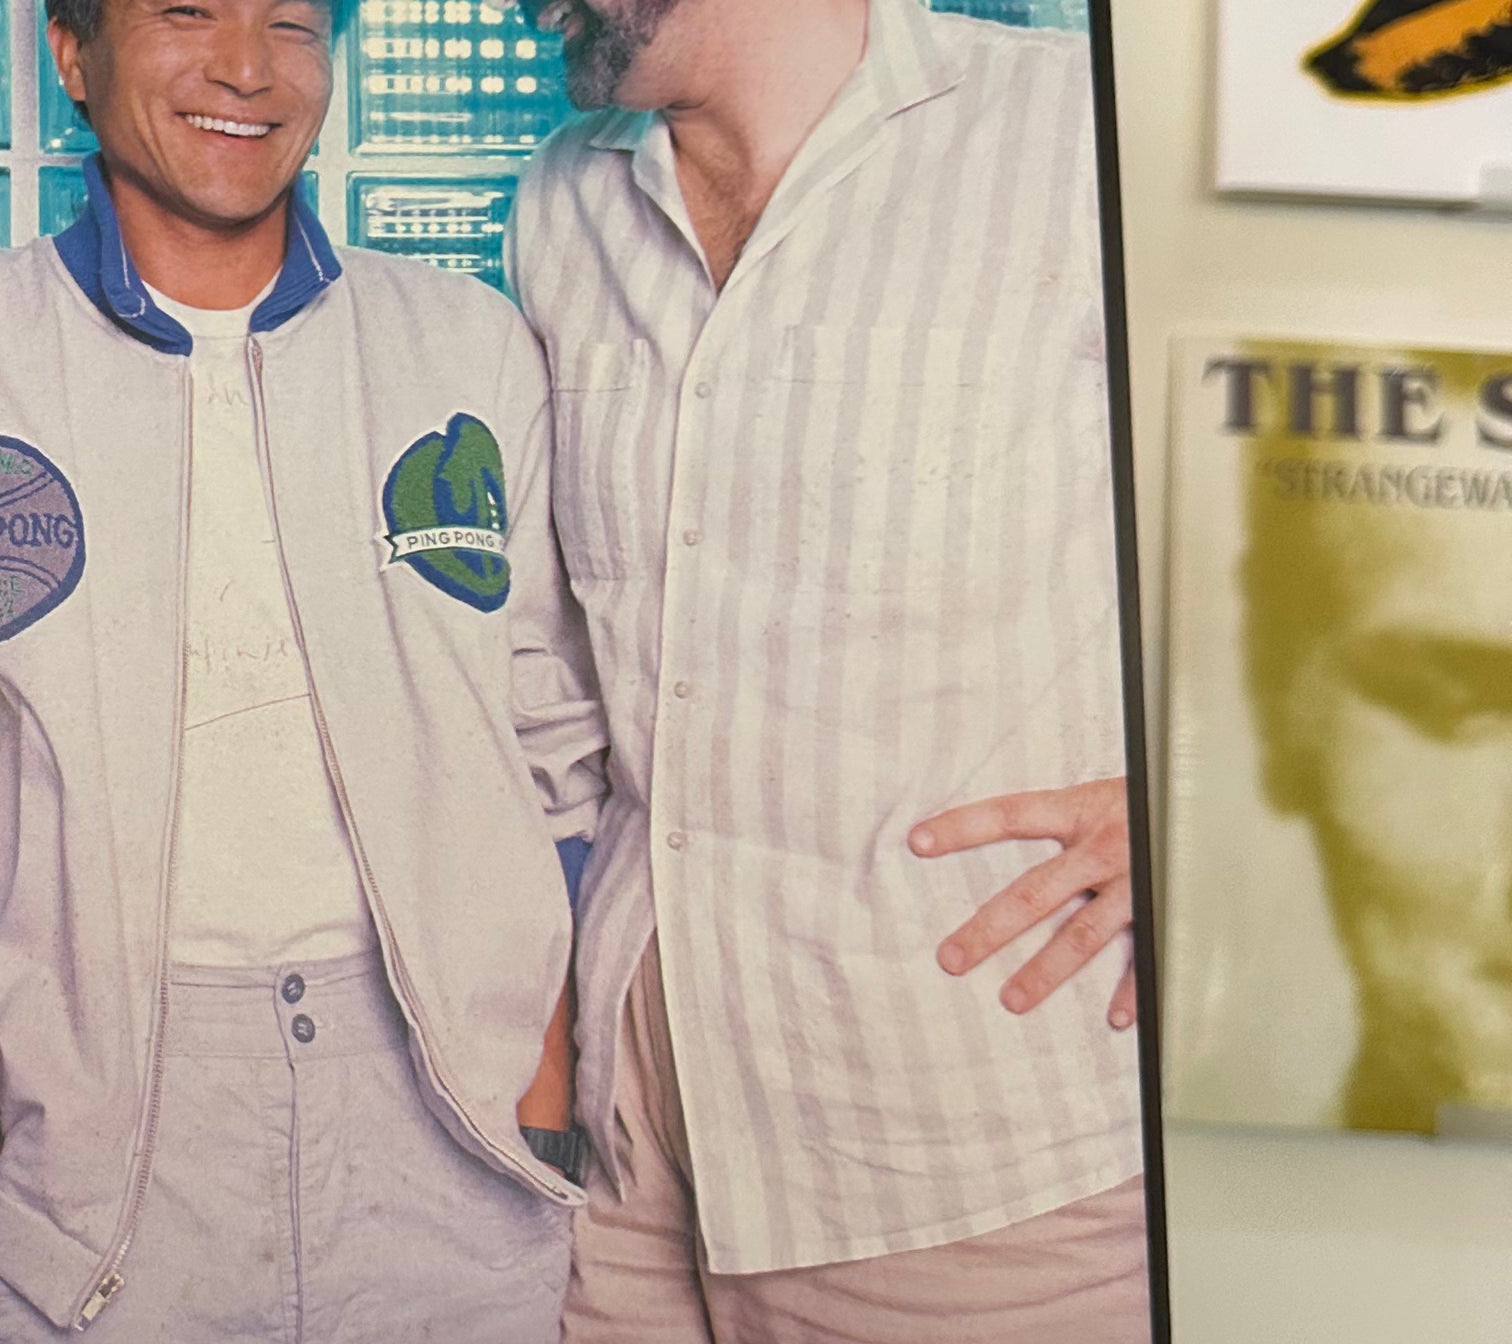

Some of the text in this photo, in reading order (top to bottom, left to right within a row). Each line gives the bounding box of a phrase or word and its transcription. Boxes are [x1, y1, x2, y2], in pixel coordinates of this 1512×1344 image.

[1202, 354, 1446, 445] THE
[406, 530, 495, 550] PING PONG
